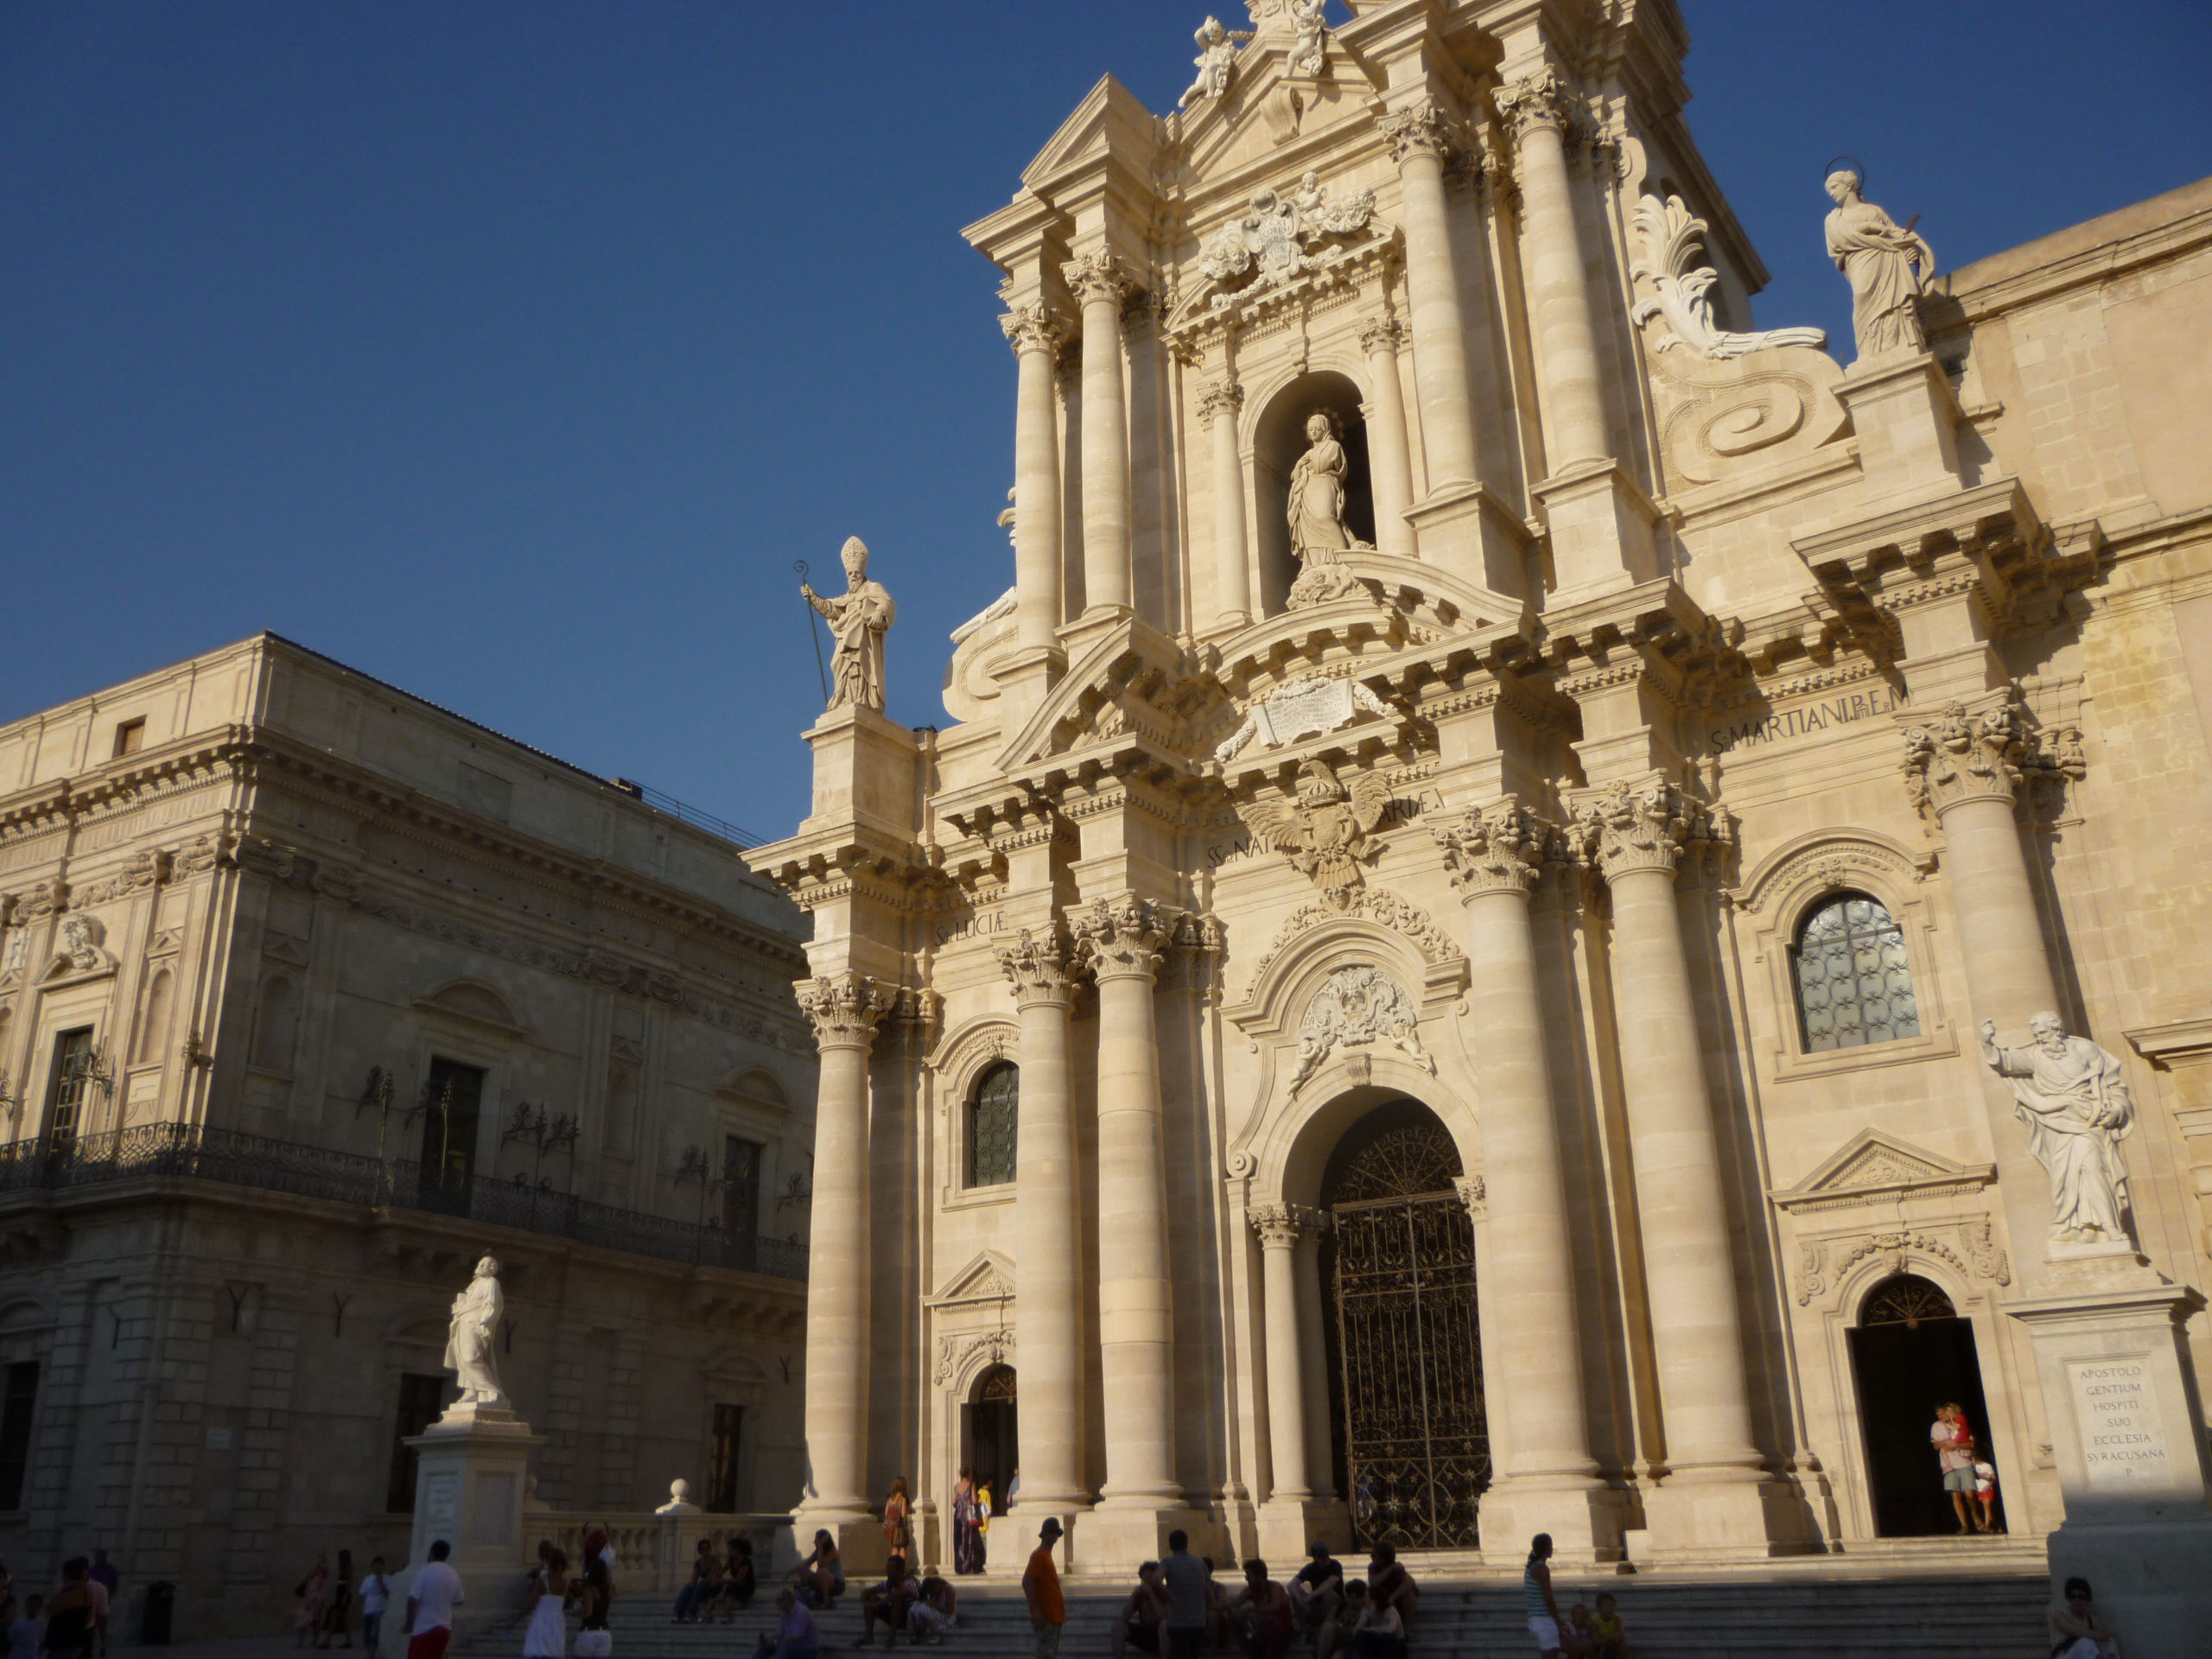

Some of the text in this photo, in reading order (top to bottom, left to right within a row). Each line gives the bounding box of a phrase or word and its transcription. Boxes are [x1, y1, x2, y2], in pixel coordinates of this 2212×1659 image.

[2080, 1366, 2141, 1379] APOSTOLO
[2086, 1382, 2142, 1396] GENTIUM
[2094, 1400, 2139, 1412] HOSPITI
[2107, 1417, 2132, 1427] SUO
[2094, 1433, 2152, 1446] ECCLESIA
